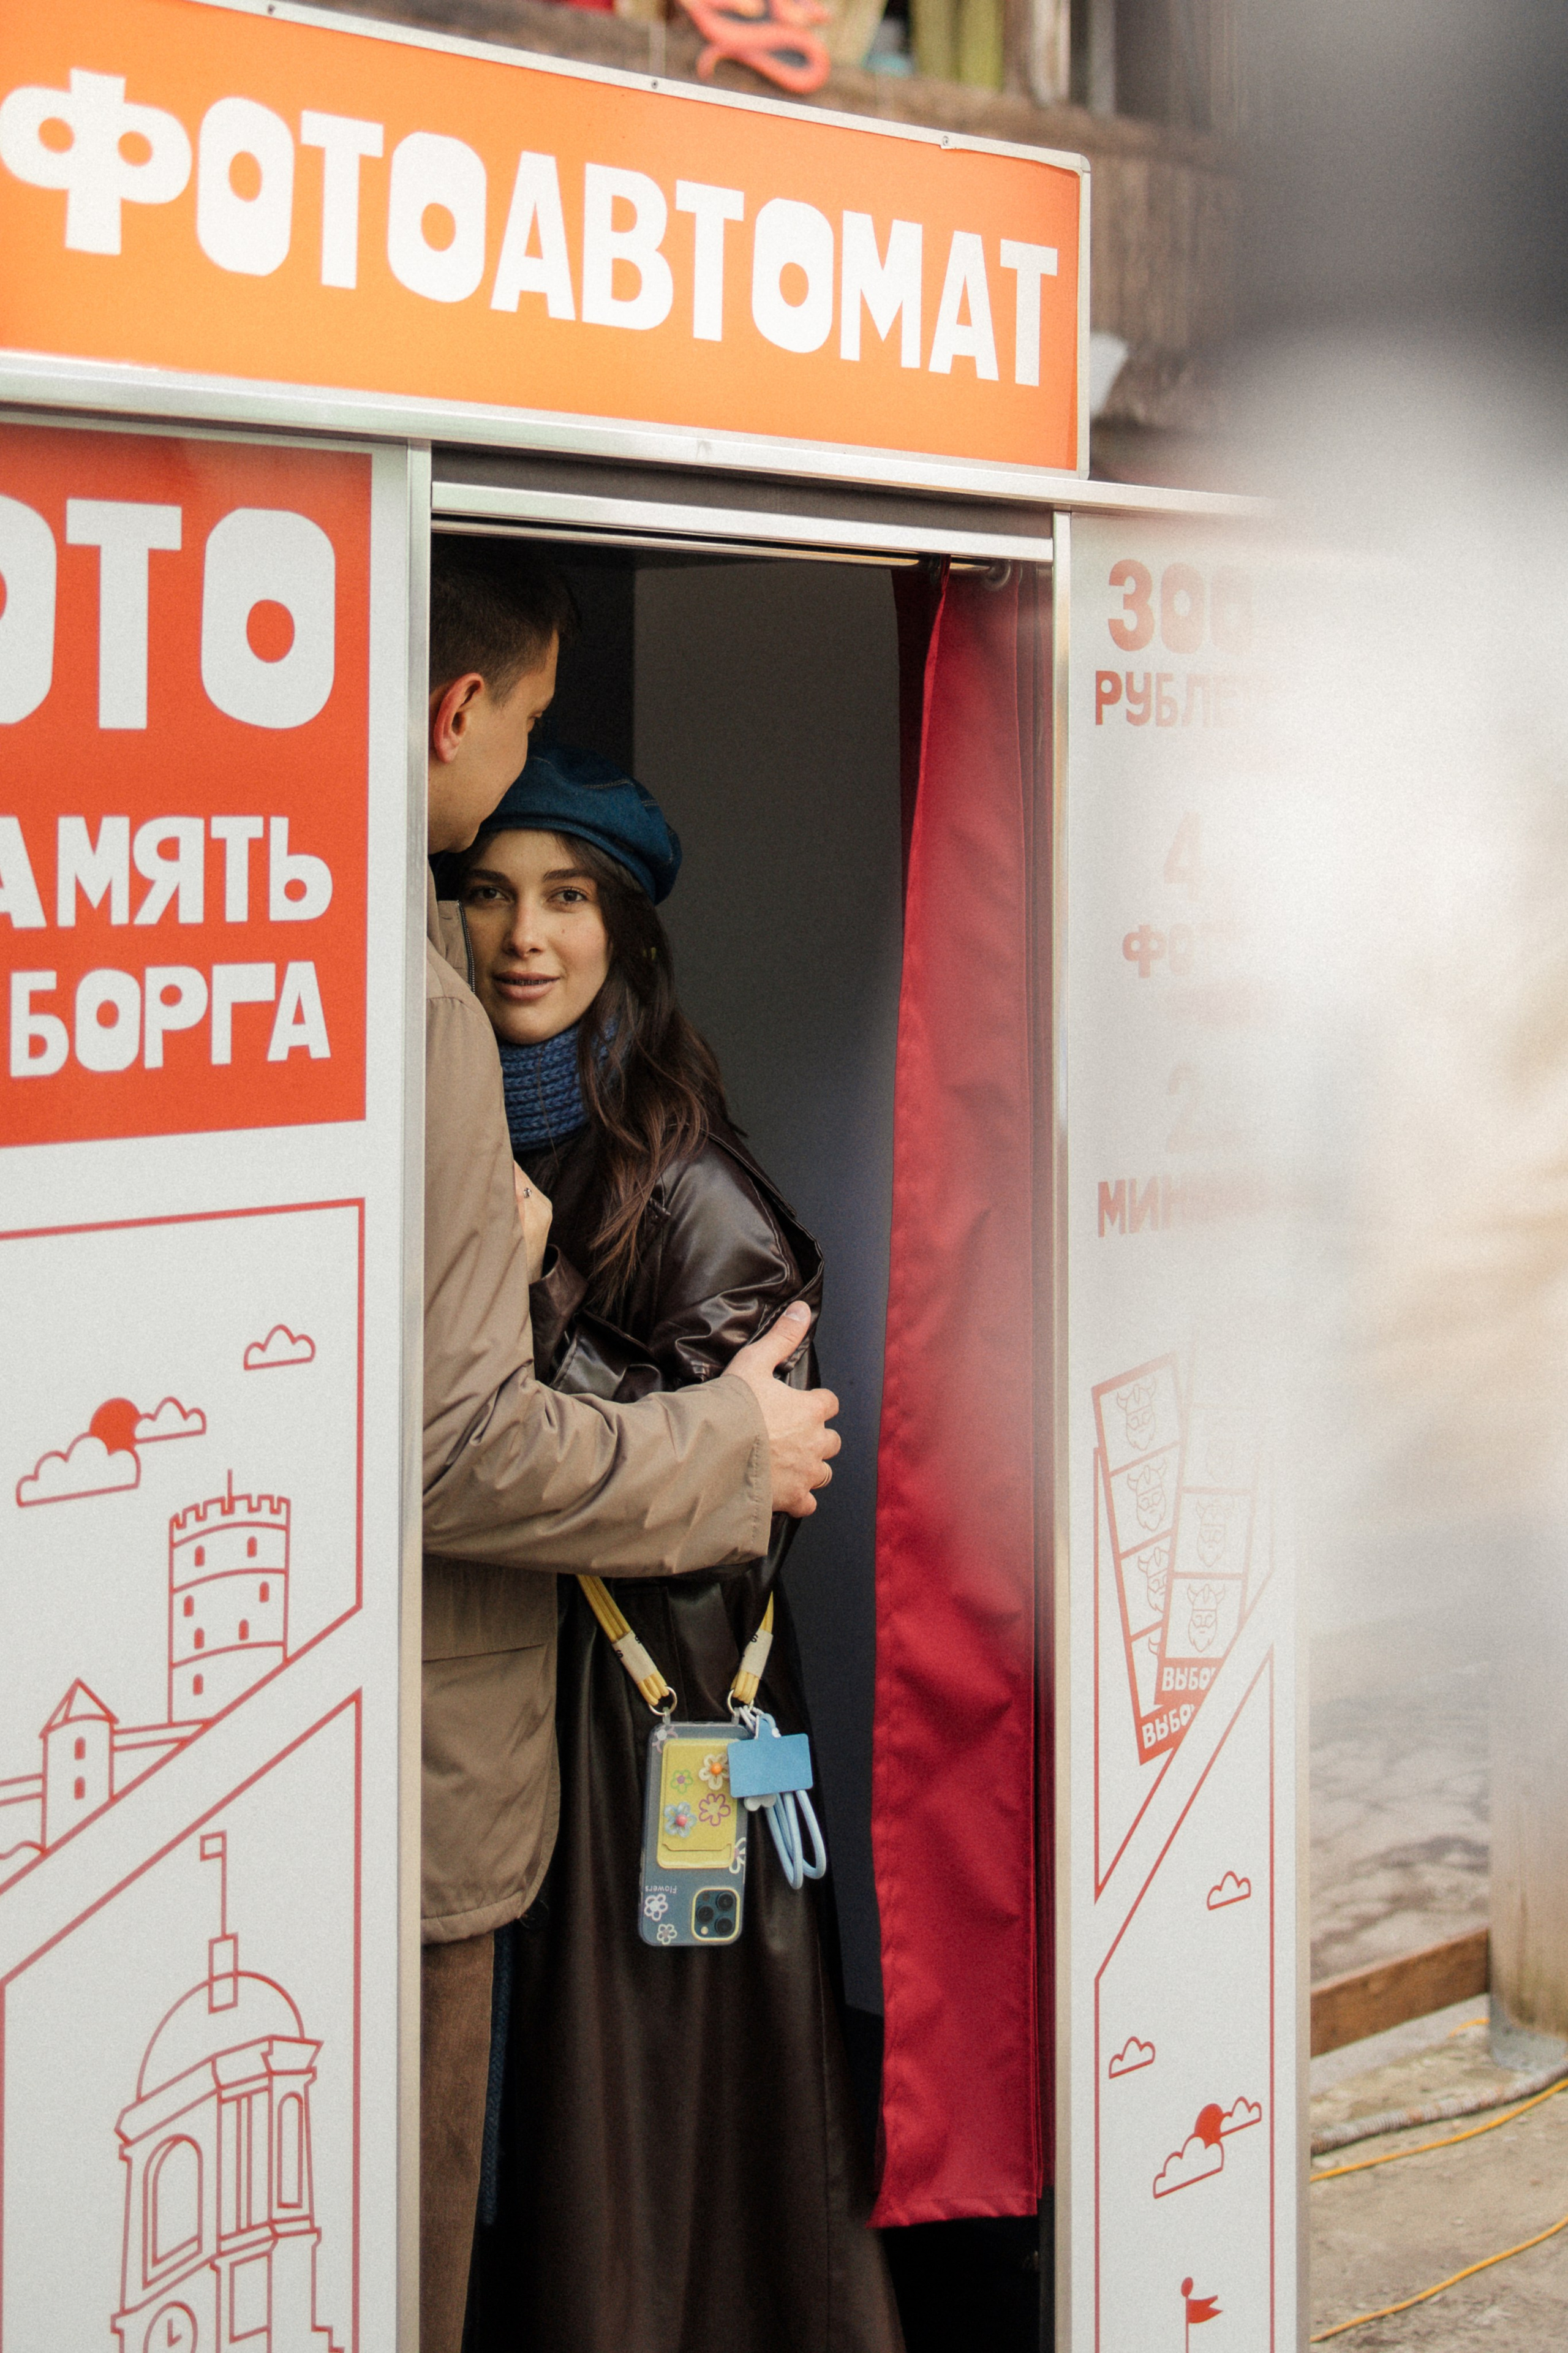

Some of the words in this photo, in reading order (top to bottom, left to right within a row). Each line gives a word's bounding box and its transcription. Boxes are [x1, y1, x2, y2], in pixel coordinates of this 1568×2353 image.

[0, 67, 1058, 387] ФОТОАВТОМАТ
[10, 961, 331, 1078] БОРГА
[645, 1885, 677, 1894] Flowers
